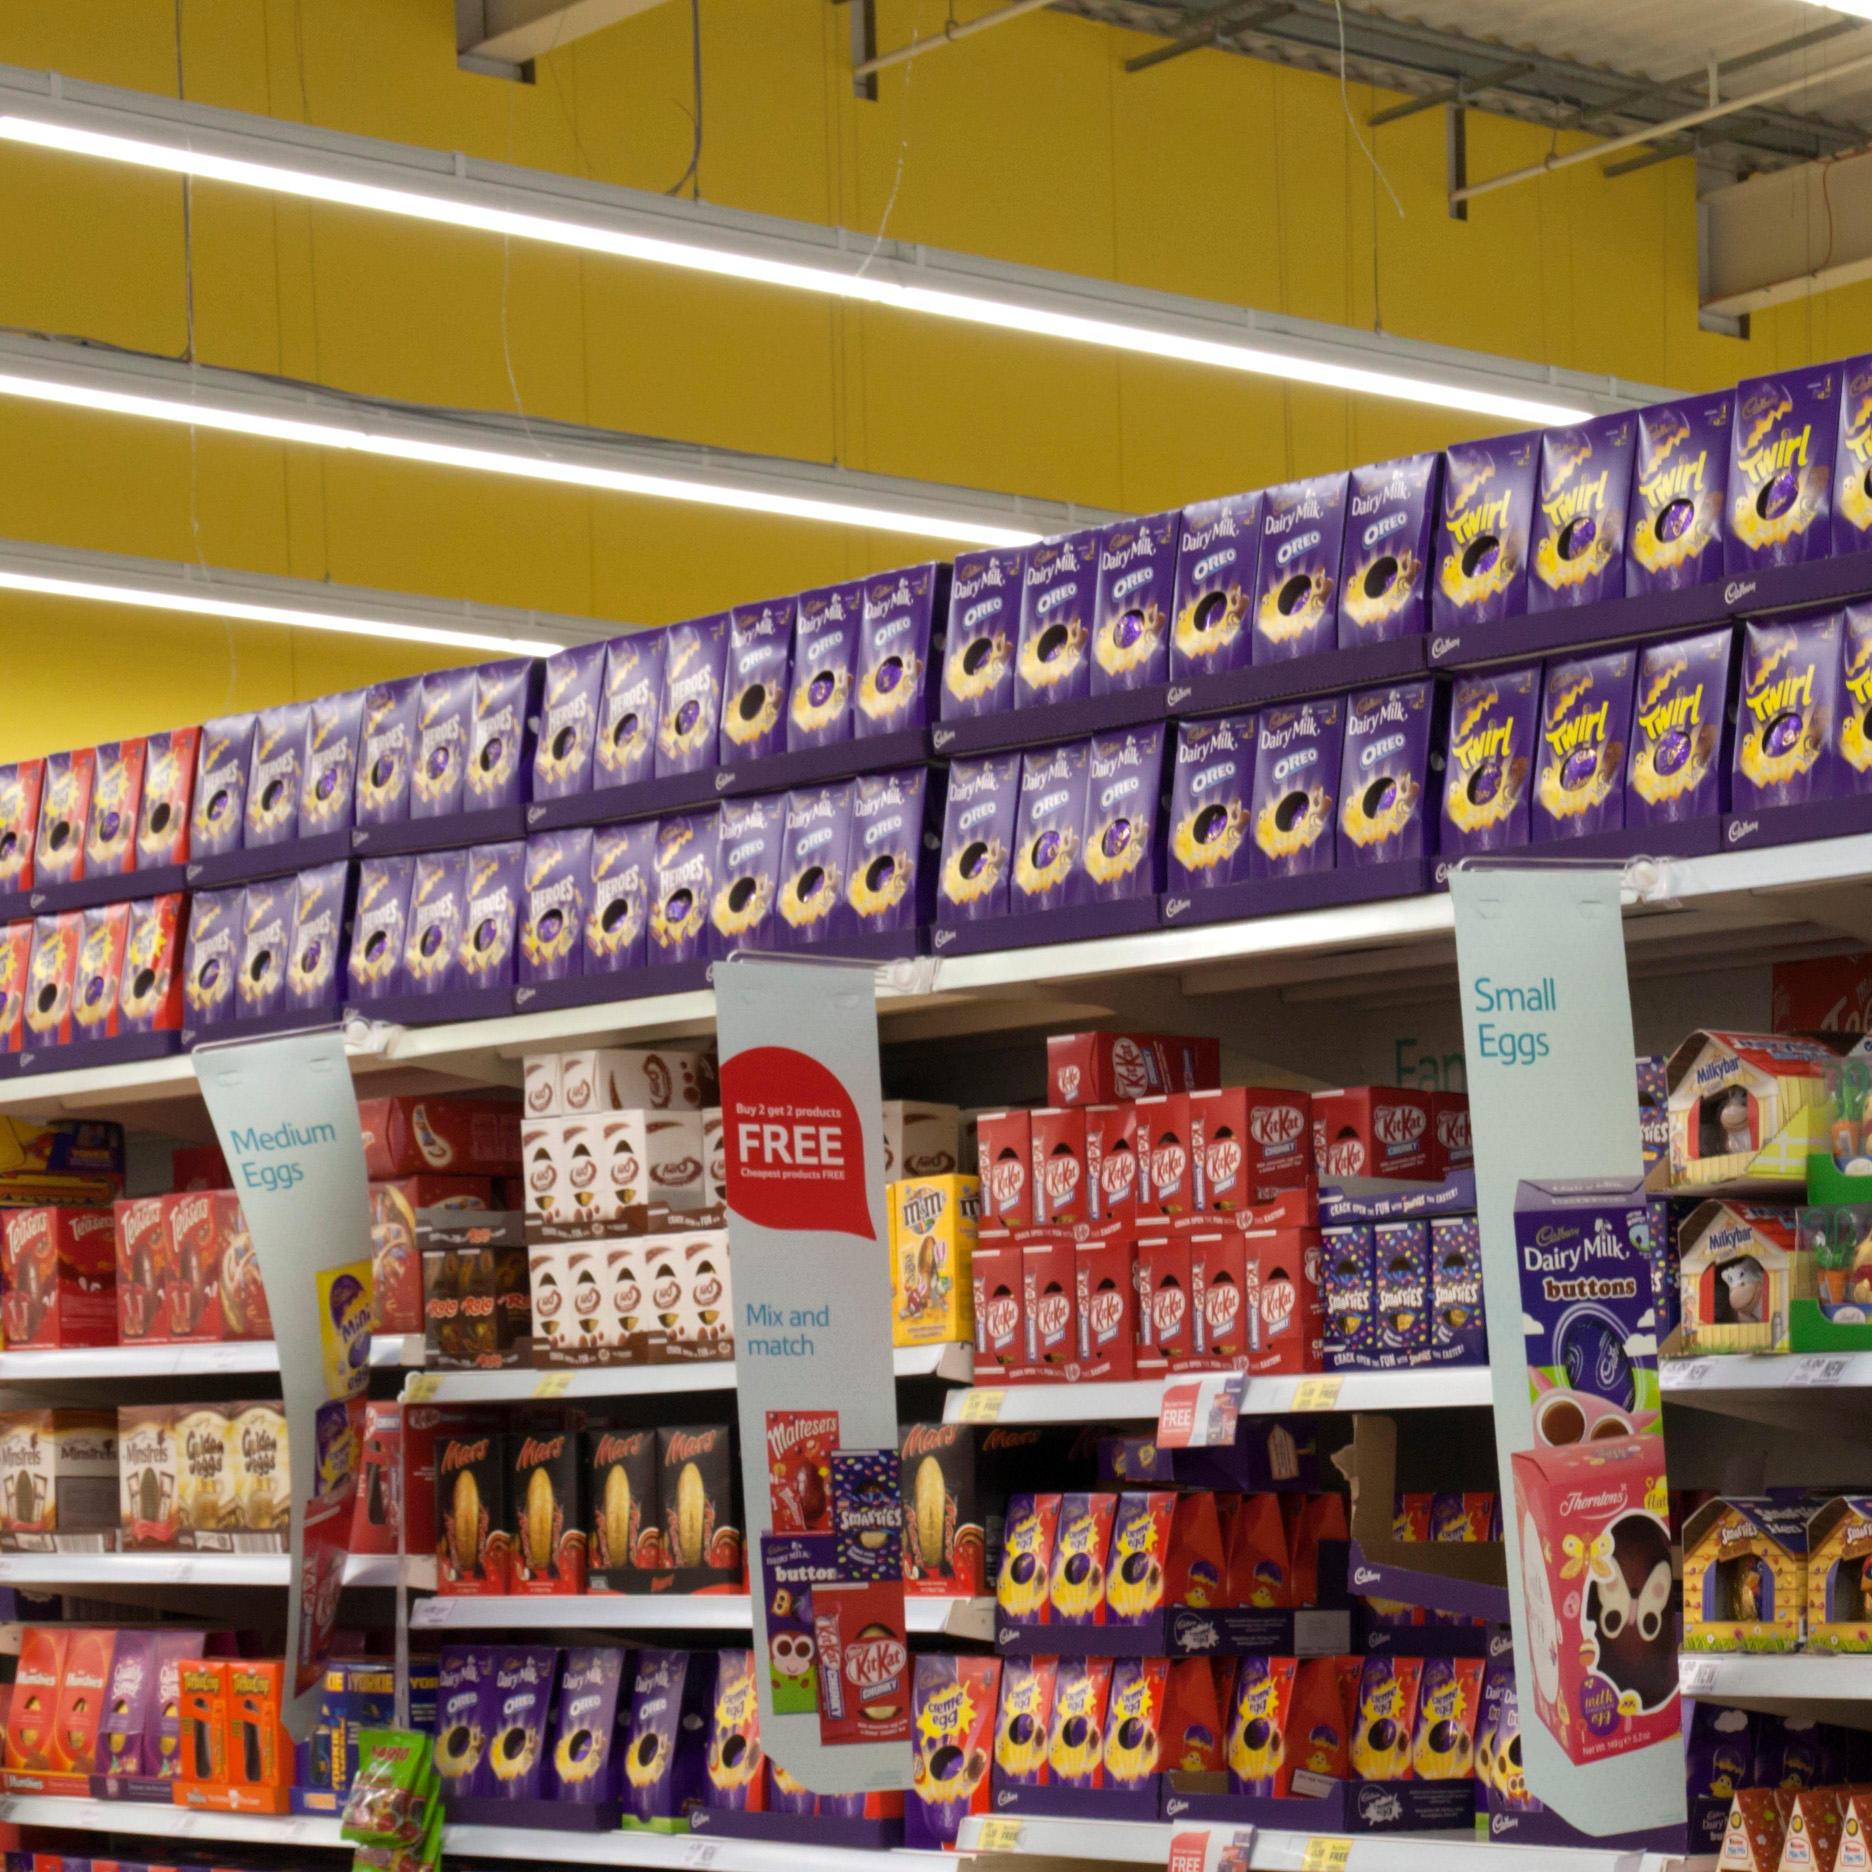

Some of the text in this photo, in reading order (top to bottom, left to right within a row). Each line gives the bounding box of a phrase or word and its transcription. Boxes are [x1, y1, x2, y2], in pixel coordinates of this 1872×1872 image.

[1473, 975, 1558, 1014] Small
[1478, 1022, 1551, 1065] Eggs
[736, 1103, 841, 1119] Buy 2 get 2 products
[230, 1119, 336, 1154] Medium
[738, 1123, 844, 1166] FREE
[241, 1159, 305, 1192] Eggs
[741, 1167, 845, 1181] Cheapest products FREE
[1523, 1242, 1580, 1273] Dairy
[1543, 1275, 1637, 1301] buttons
[746, 1303, 830, 1327] Mix and
[748, 1334, 815, 1357] match
[770, 1414, 837, 1456] Maltesers
[1162, 1407, 1194, 1430] FREE
[594, 1431, 645, 1464] Mars
[847, 1644, 905, 1683] KitKat
